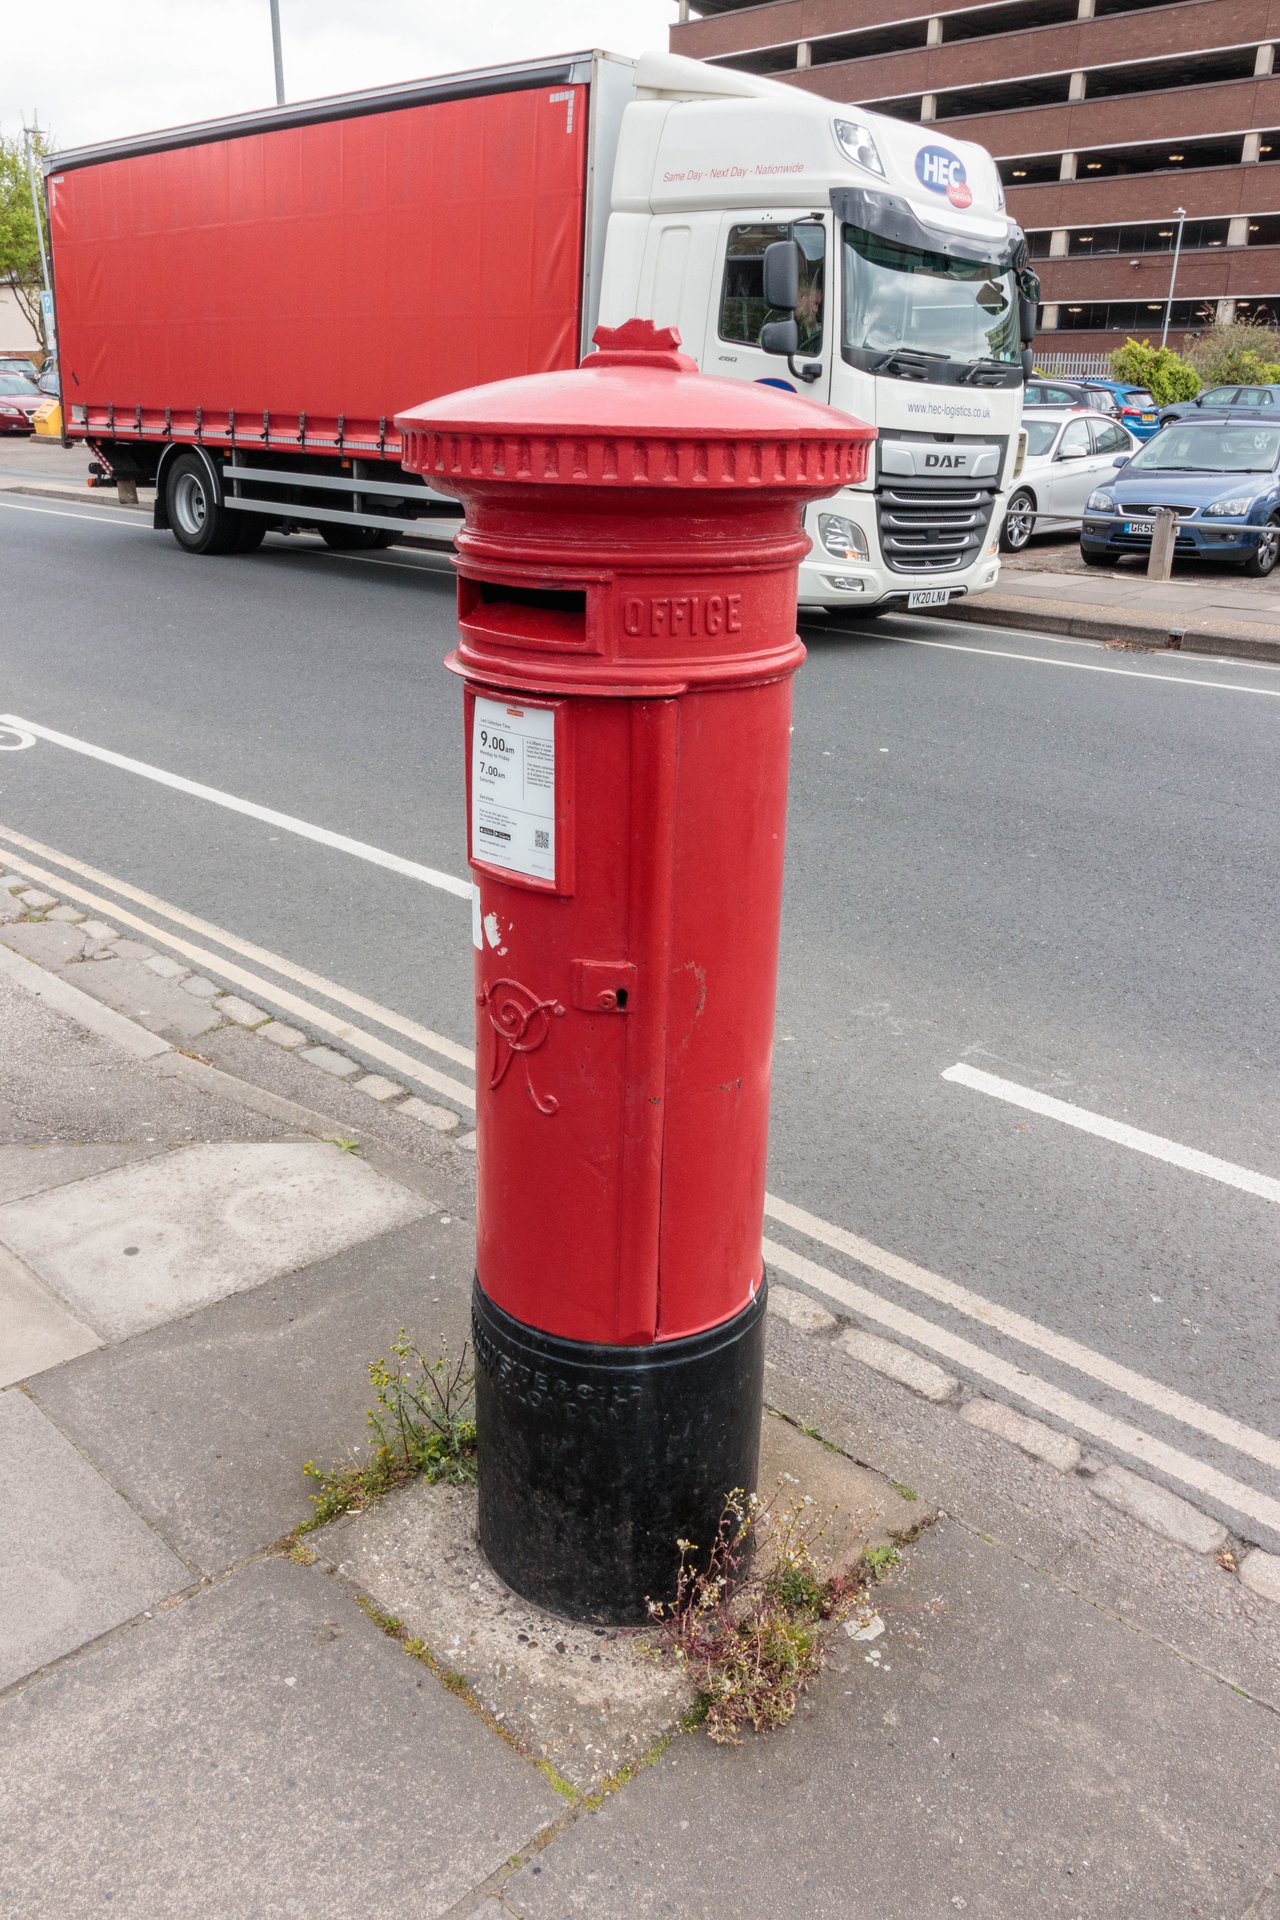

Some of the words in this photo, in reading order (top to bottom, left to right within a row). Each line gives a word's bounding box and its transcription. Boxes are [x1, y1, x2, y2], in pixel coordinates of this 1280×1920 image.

[663, 171, 685, 183] Same
[687, 170, 704, 182] Day
[709, 168, 730, 179] Next
[730, 166, 748, 178] Day
[755, 163, 804, 175] Nationwide
[923, 153, 961, 188] HEC
[907, 402, 991, 419] www.hec-logistics.co.uk
[925, 454, 967, 468] DAF
[912, 592, 931, 605] YK20
[931, 591, 946, 603] LNA
[624, 594, 742, 636] OFFICE
[480, 730, 515, 754] 9.00am
[479, 761, 506, 779] 7.00am
